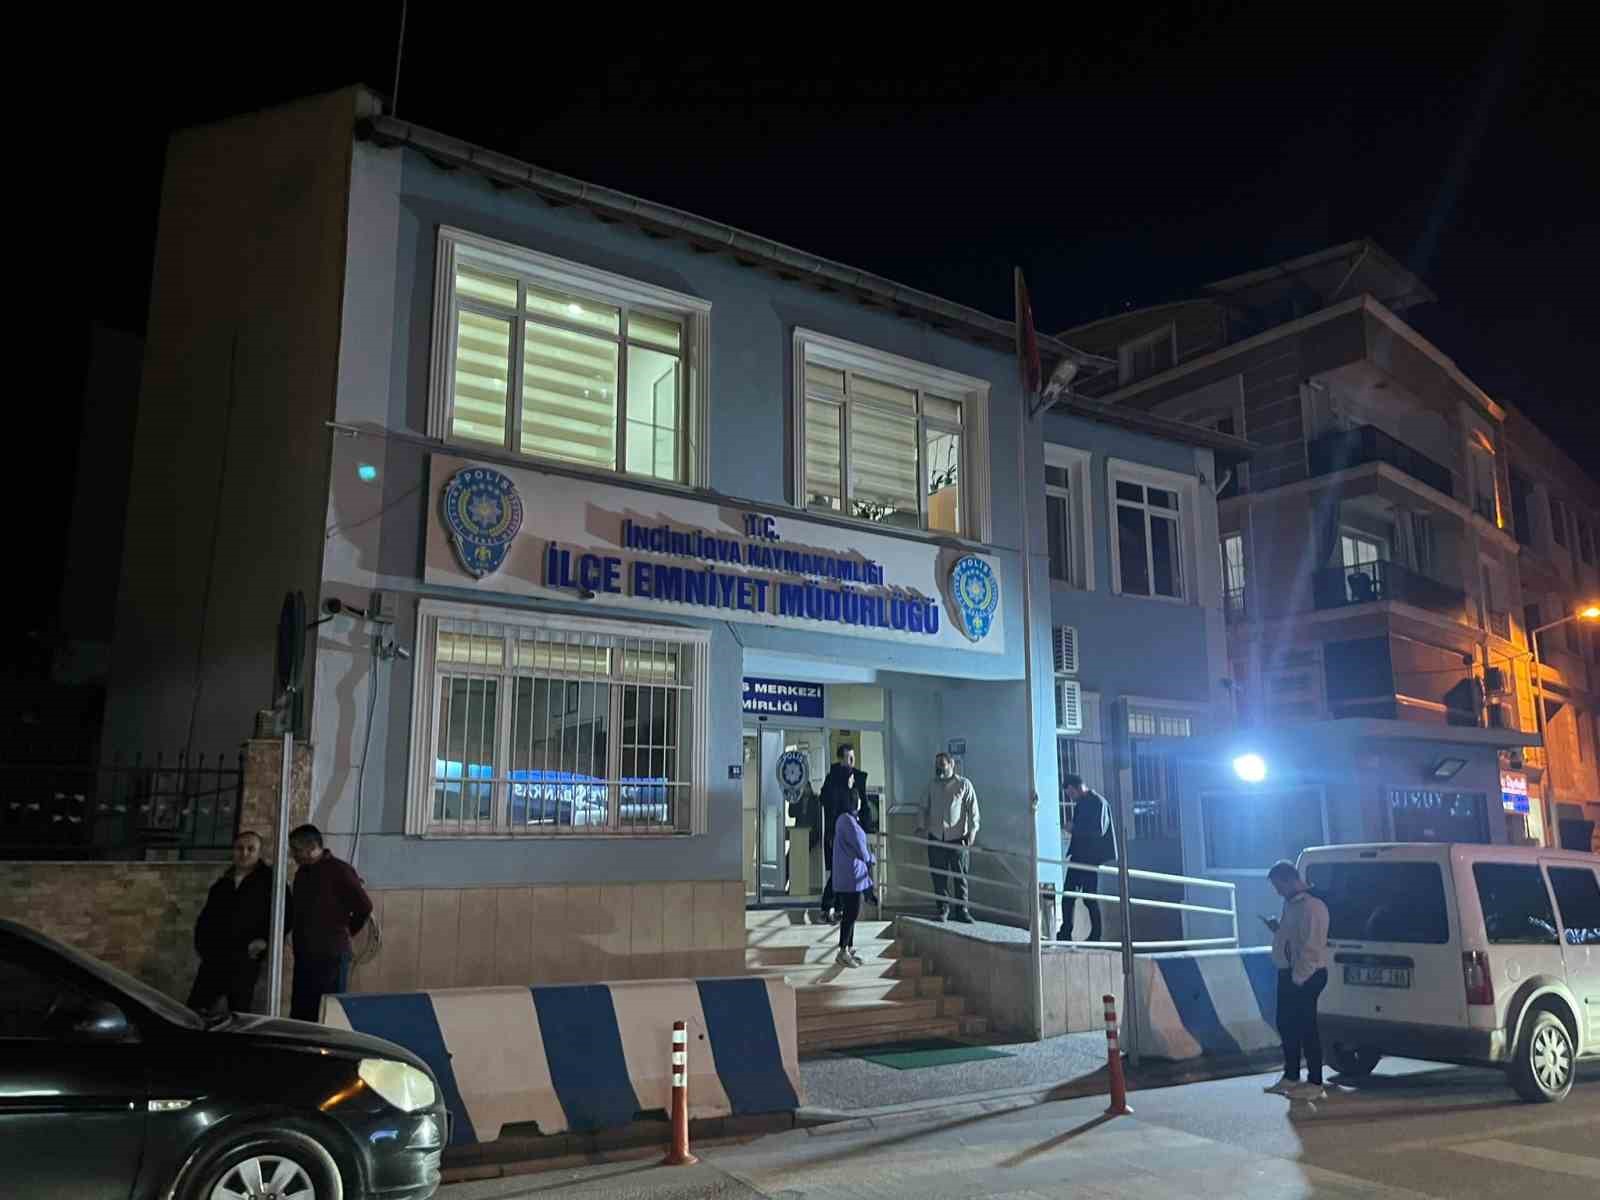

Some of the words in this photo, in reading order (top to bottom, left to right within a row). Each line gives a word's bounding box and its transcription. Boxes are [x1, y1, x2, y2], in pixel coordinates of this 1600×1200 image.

[632, 557, 769, 614] EMNİYET
[777, 579, 940, 635] MÜDÜRLÜĞÜ
[755, 683, 821, 698] MERKEZİ
